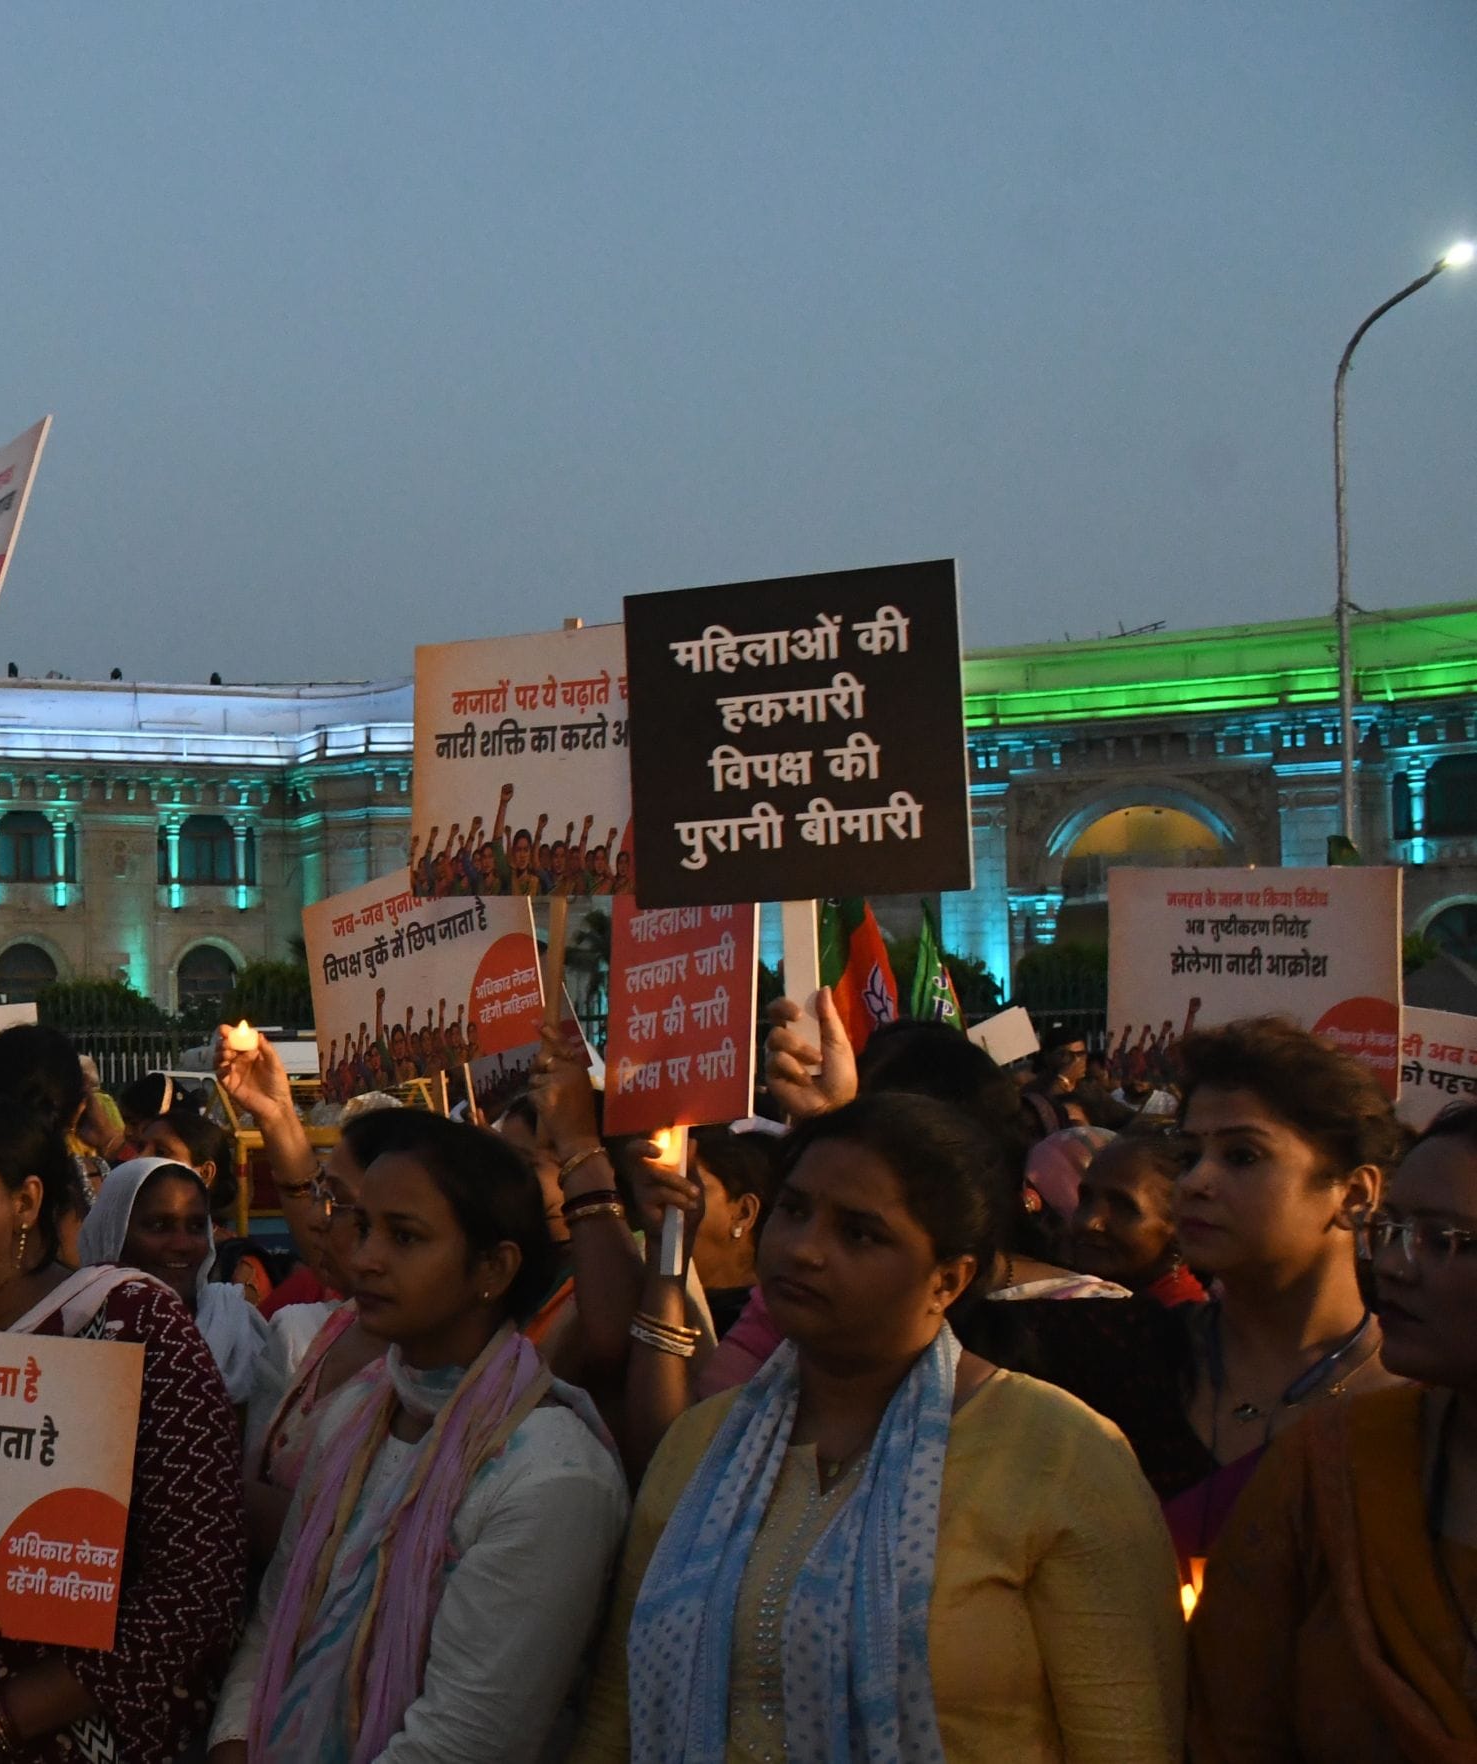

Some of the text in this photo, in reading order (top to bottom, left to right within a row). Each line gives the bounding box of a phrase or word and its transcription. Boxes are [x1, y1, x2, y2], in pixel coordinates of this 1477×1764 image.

[669, 605, 910, 674] महिलाओं की
[452, 680, 510, 715] मजारों
[514, 685, 538, 711] पर
[542, 674, 557, 708] ये
[716, 672, 866, 733] हकमारी
[435, 722, 476, 759] नारी
[480, 718, 526, 757] शक्ति
[530, 725, 557, 752] का
[560, 713, 608, 750] करते
[707, 732, 881, 791] विपक्ष की
[674, 791, 923, 869] पुरानी बीमारी
[323, 951, 361, 985] विपक्ष
[390, 928, 405, 958] में
[406, 921, 436, 954] छिप
[437, 908, 474, 940] जाता
[475, 896, 487, 931] है
[332, 902, 383, 936] जब-जब
[629, 907, 702, 943] महिलाओ
[1186, 914, 1311, 942] अब तुष्टीकरण गिरोह
[476, 967, 536, 999] अधिकार लेकर
[625, 931, 736, 994] ललकार जारी
[1225, 947, 1263, 975] नारी
[1266, 949, 1328, 977] आक्रोश
[627, 986, 730, 1044] देश की नारी
[617, 1037, 737, 1096] विपक्ष पर भारी
[1428, 1043, 1465, 1064] अब
[23, 1356, 42, 1403] है
[39, 1415, 59, 1467] है
[9, 1532, 119, 1568] अधिकार लेकर
[6, 1563, 115, 1603] रहेंगी महिलाएं
